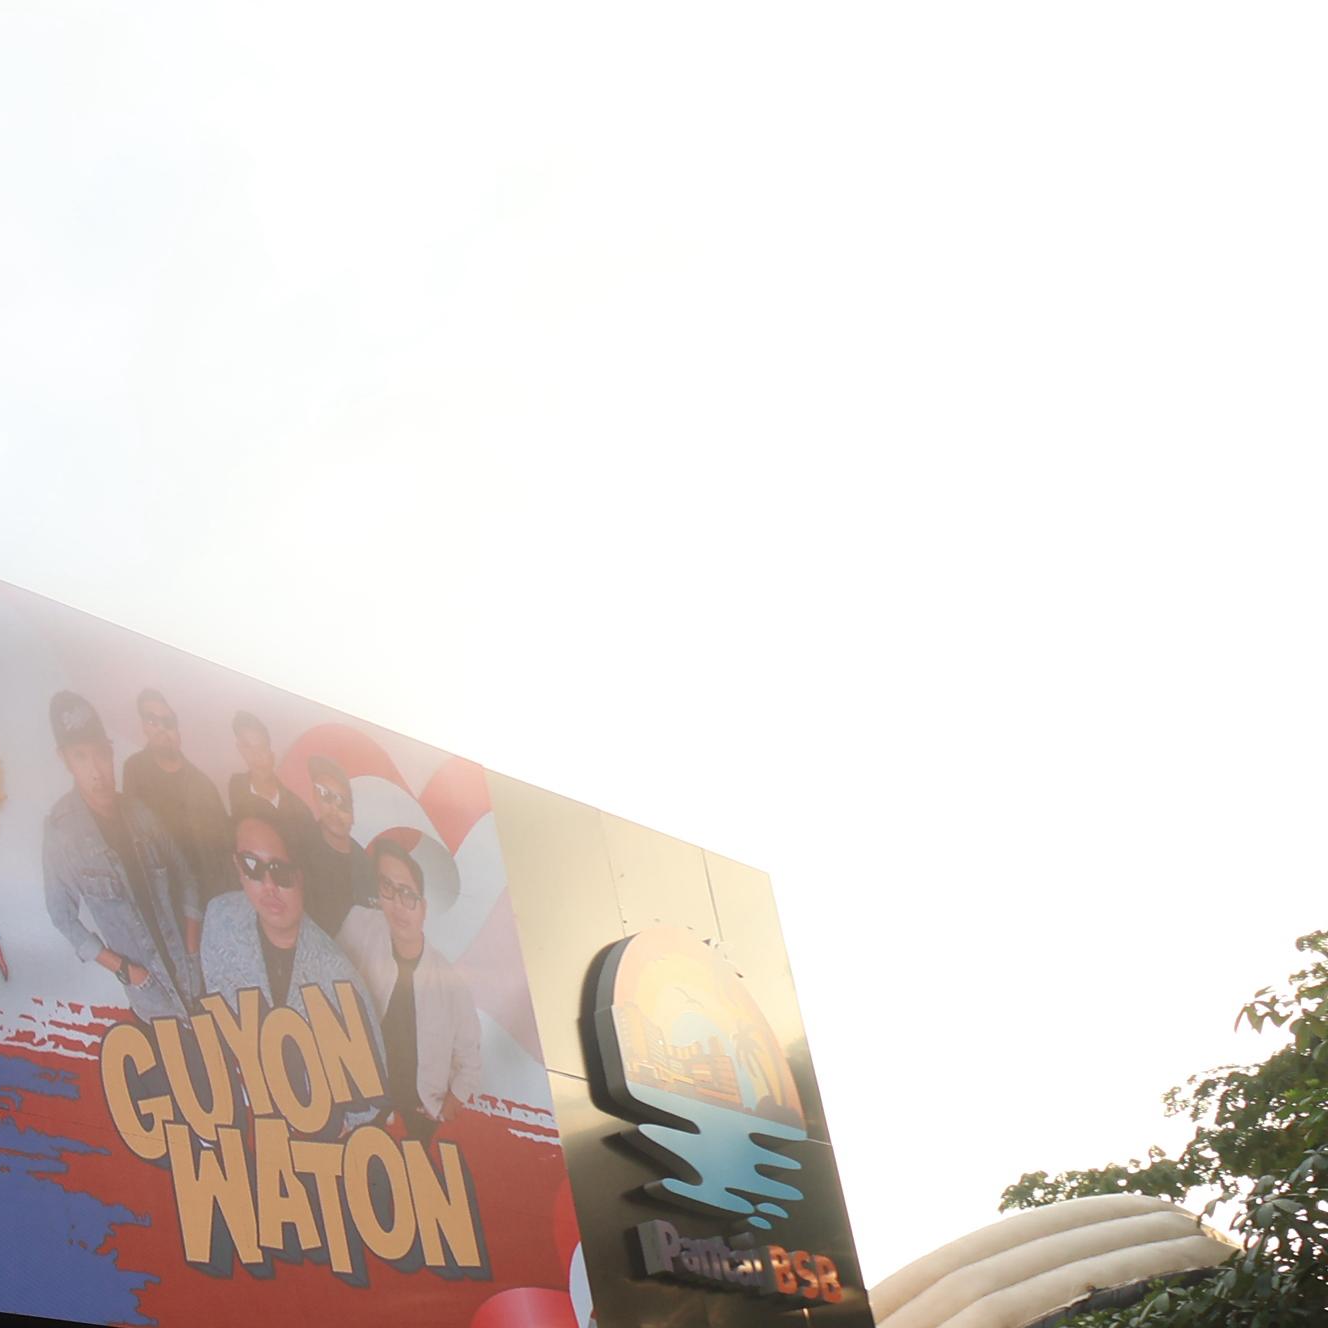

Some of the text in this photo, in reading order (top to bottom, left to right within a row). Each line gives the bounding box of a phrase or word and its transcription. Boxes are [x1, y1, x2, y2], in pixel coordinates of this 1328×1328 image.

[101, 981, 384, 1162] GUYON
[167, 1116, 482, 1273] WATON
[638, 1219, 844, 1304] Pantai BSB
